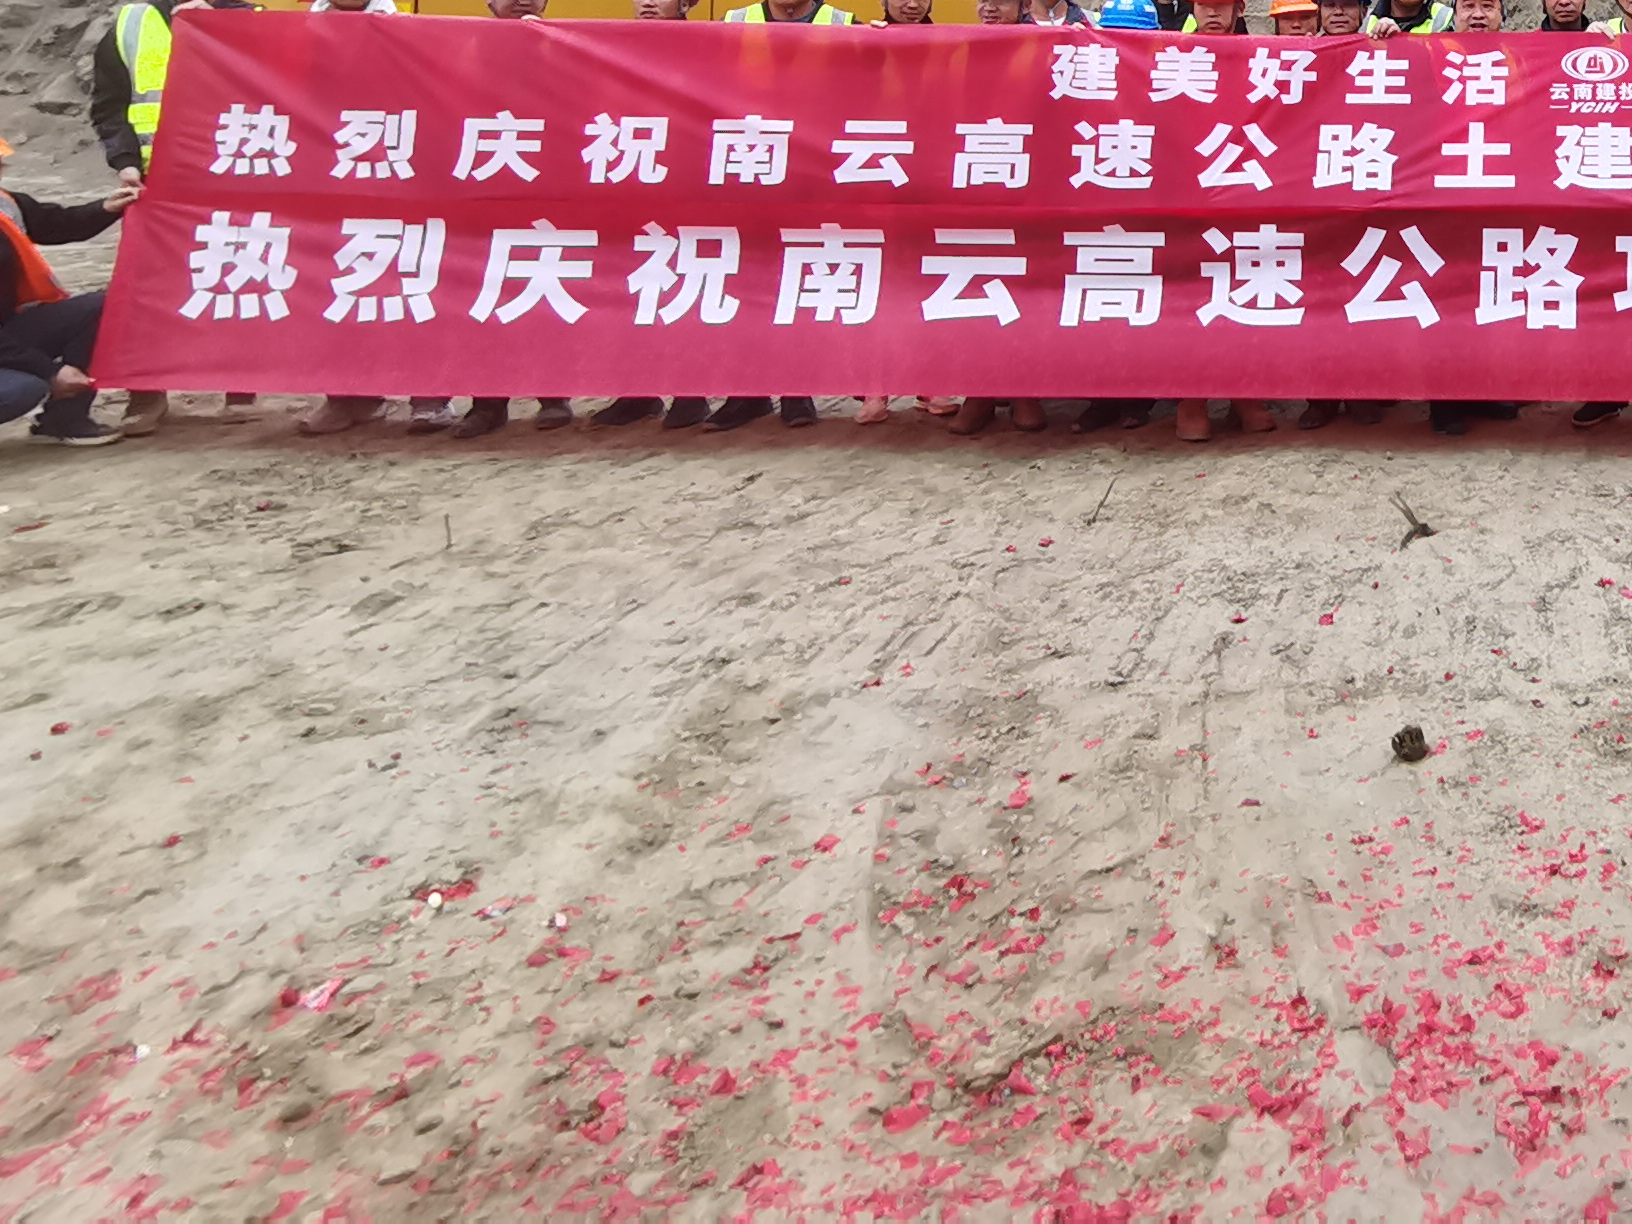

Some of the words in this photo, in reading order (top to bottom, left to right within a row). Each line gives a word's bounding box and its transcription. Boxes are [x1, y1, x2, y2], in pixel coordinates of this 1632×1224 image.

[1049, 43, 1511, 107] 建美好生活
[1569, 101, 1620, 114] YCIH
